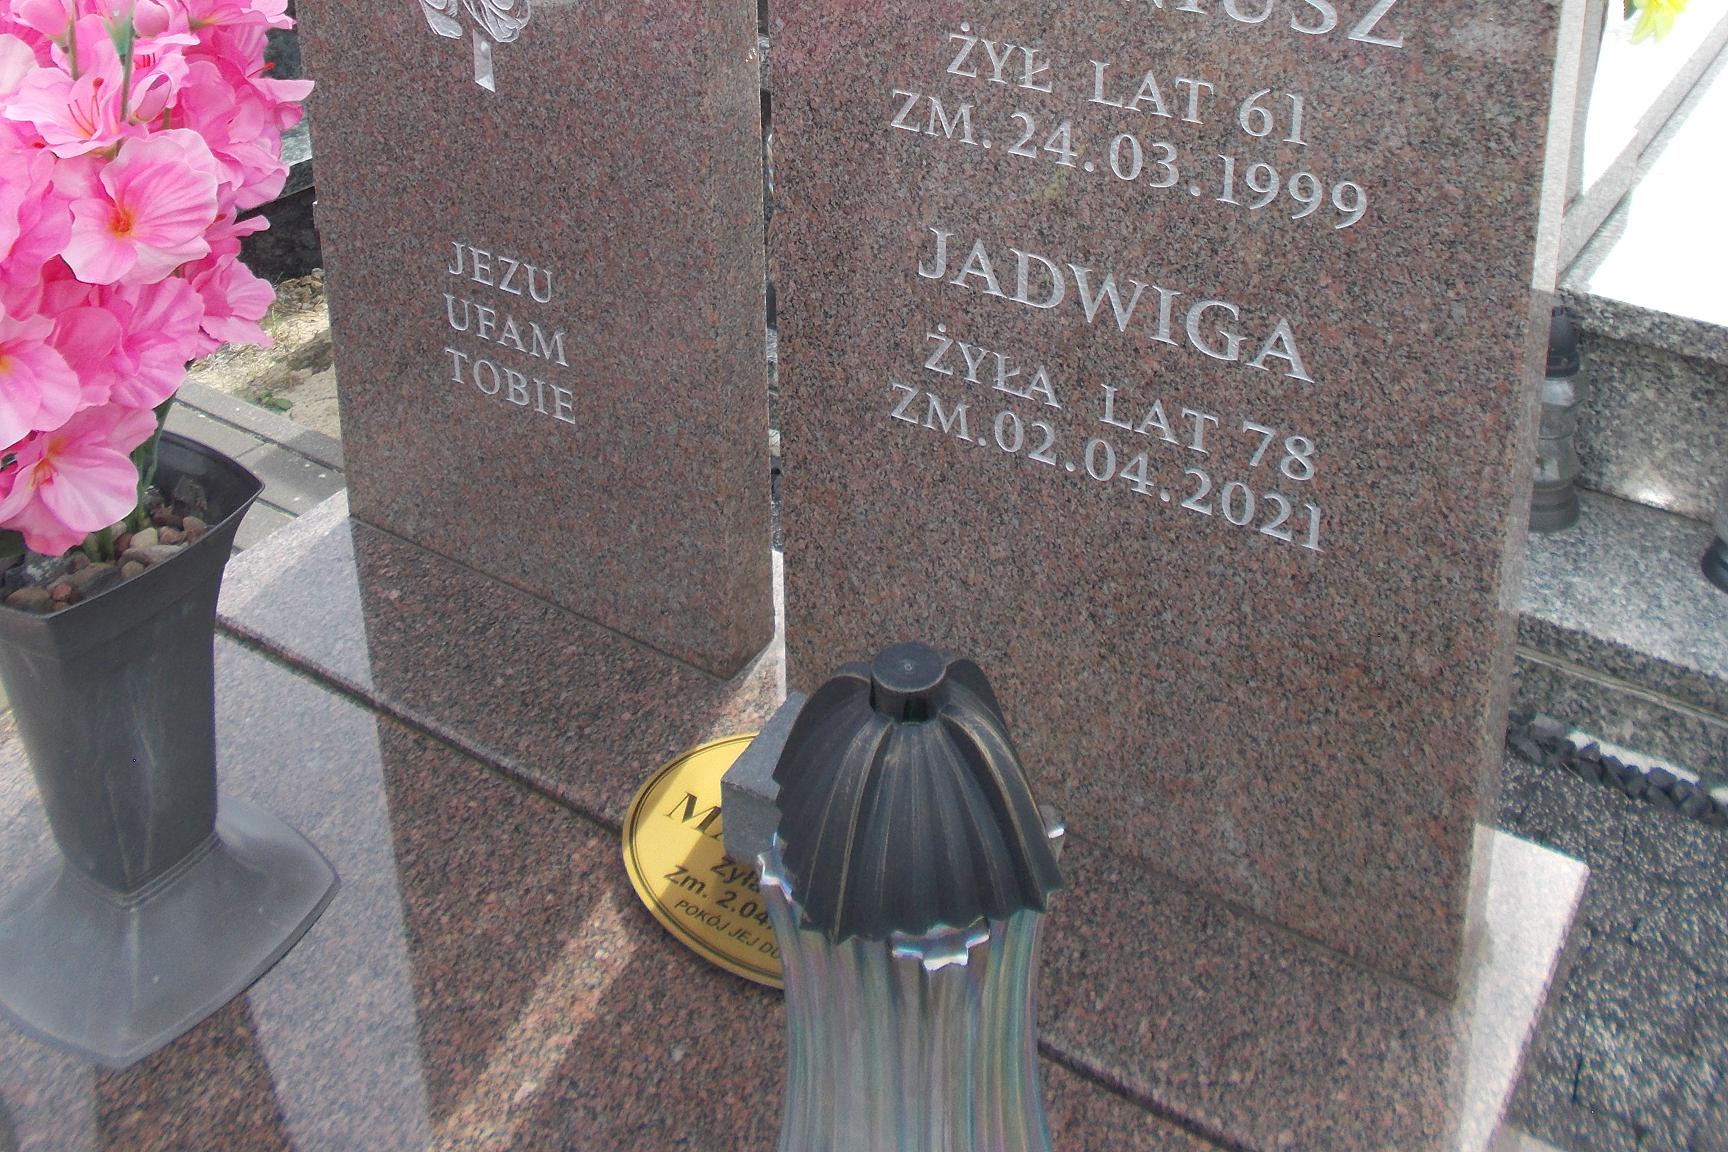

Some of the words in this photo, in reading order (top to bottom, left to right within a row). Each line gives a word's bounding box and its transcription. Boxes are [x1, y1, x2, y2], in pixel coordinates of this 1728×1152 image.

[946, 22, 1053, 93] ŻYŁ
[1088, 59, 1214, 124] LAT
[1239, 88, 1308, 146] 61
[448, 241, 553, 304] JEZU
[918, 227, 1315, 384] JADWIGA
[443, 293, 570, 368] UFAM
[444, 347, 577, 425] TOBIE
[924, 323, 1062, 409] ŻYŁA
[1101, 384, 1220, 454] LAT
[1242, 420, 1316, 482] 78
[673, 899, 730, 933] POKÓJ
[728, 928, 760, 946] JEJ
[757, 940, 783, 961] DU
[715, 890, 773, 930] 2.04.
